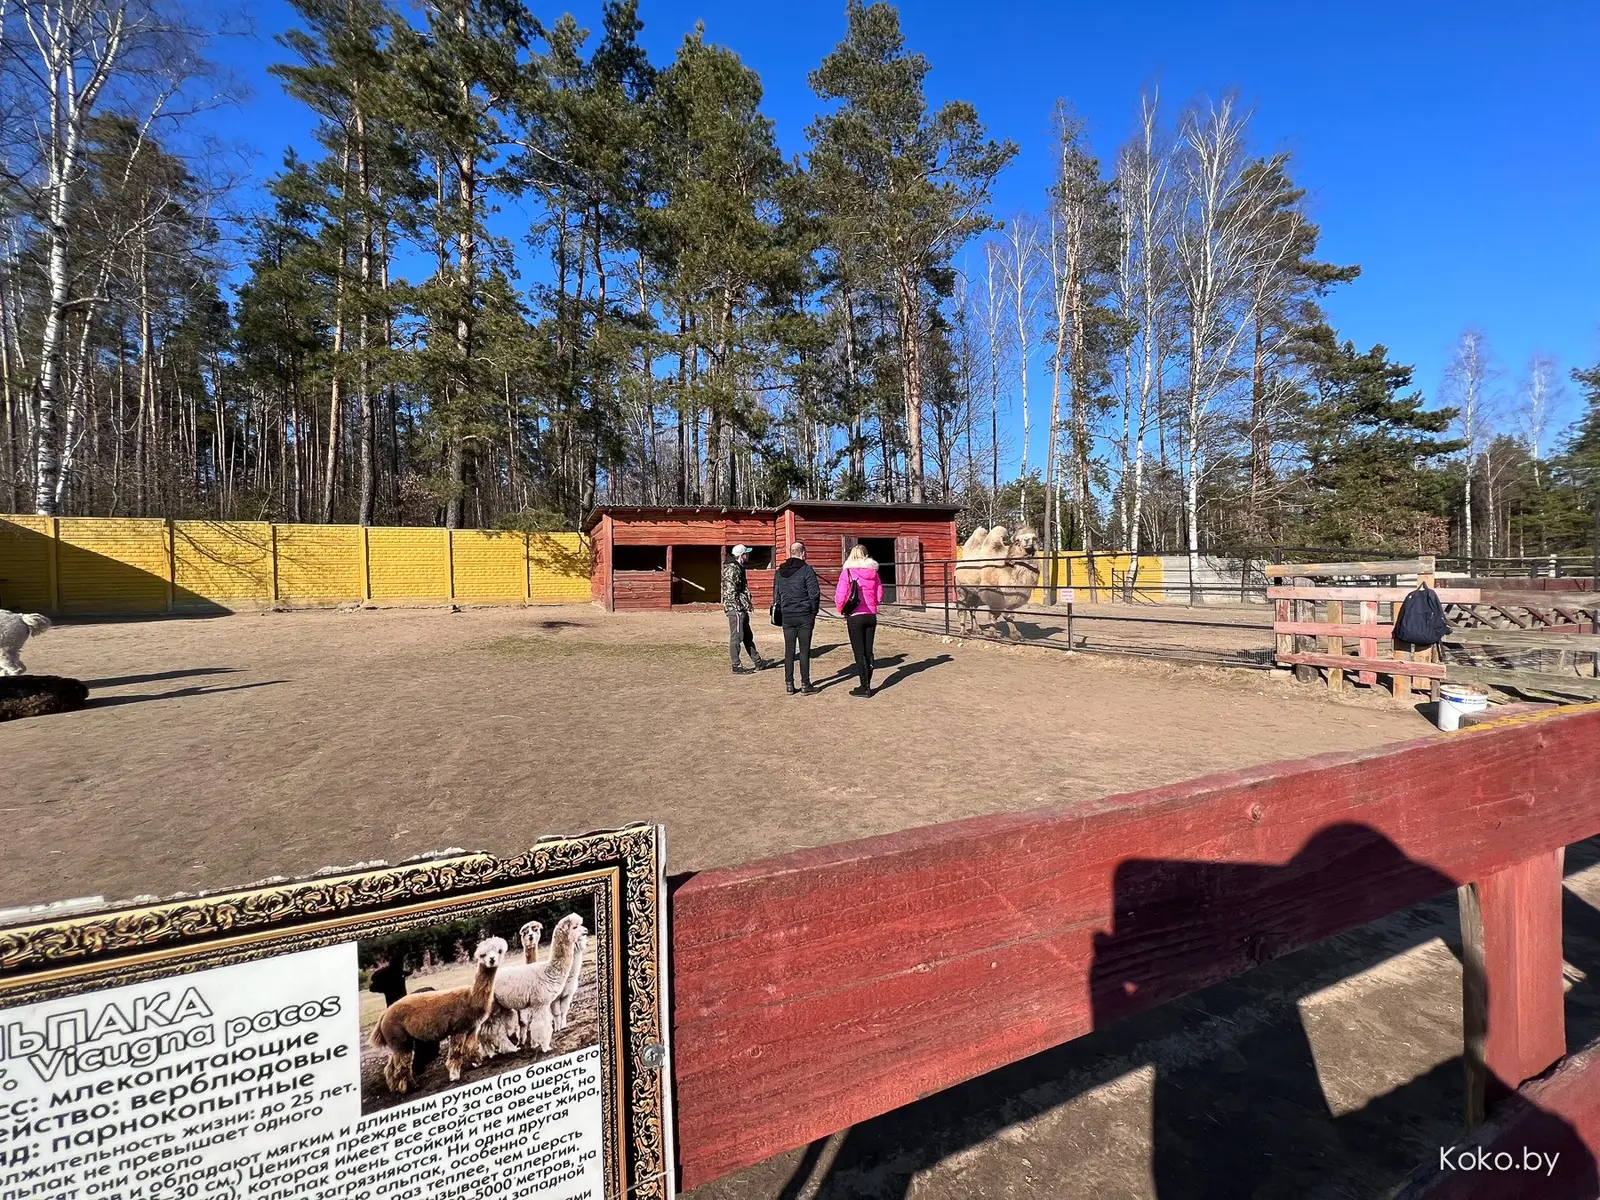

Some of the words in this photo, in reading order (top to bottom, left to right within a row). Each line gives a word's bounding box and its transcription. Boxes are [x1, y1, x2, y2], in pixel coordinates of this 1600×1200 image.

[27, 1024, 215, 1082] Vicugna
[225, 996, 341, 1045] pacos
[49, 1031, 319, 1108] млекопитающие
[131, 1044, 348, 1110] верблюдовые
[0, 1133, 175, 1187] лжительность
[182, 1110, 255, 1138] жизни:
[261, 1102, 285, 1119] до
[290, 1091, 314, 1110] 25
[320, 1083, 357, 1103] лет.
[53, 1073, 314, 1152] парнокопытные
[84, 1165, 110, 1180] не
[119, 1126, 249, 1171] превышает
[254, 1106, 323, 1132] одного
[130, 1187, 142, 1199] и
[149, 1152, 261, 1192] обладают
[266, 1131, 334, 1159] мягким
[340, 1125, 350, 1137] и
[356, 1100, 437, 1134] длинным
[442, 1082, 493, 1107] руном
[497, 1074, 521, 1090] (по
[526, 1058, 572, 1079] бокам
[576, 1049, 599, 1063] его
[249, 1146, 330, 1179] Ценится
[337, 1123, 407, 1152] прежде
[413, 1107, 458, 1128] всего
[463, 1099, 481, 1113] за
[485, 1085, 526, 1104] свою
[531, 1067, 586, 1090] шерсть
[249, 1161, 328, 1194] которая
[335, 1142, 389, 1167] имеет
[395, 1131, 422, 1148] все
[428, 1105, 503, 1136] свойства
[508, 1081, 573, 1110] овечьей,
[578, 1075, 596, 1088] но
[335, 1157, 389, 1181] очень
[395, 1129, 463, 1161] стойкий
[469, 1126, 478, 1137] и
[483, 1119, 501, 1132] не
[507, 1102, 551, 1124] имеет
[556, 1087, 600, 1108] жира,
[86, 1175, 128, 1195] они
[136, 1155, 203, 1180] около
[316, 1154, 442, 1200] загрязняются.
[448, 1142, 469, 1157] Ни
[475, 1128, 513, 1148] одна
[518, 1109, 568, 1135] другая
[376, 1166, 446, 1195] альпак,
[450, 1136, 528, 1169] особенно
[532, 1131, 540, 1140] с
[427, 1164, 489, 1191] теплее,
[494, 1150, 522, 1166] чем
[527, 1130, 582, 1156] шерсть
[503, 1144, 579, 1177] аллергии.
[512, 1163, 584, 1200] западной
[516, 1160, 574, 1186] метров,
[579, 1150, 596, 1163] на
